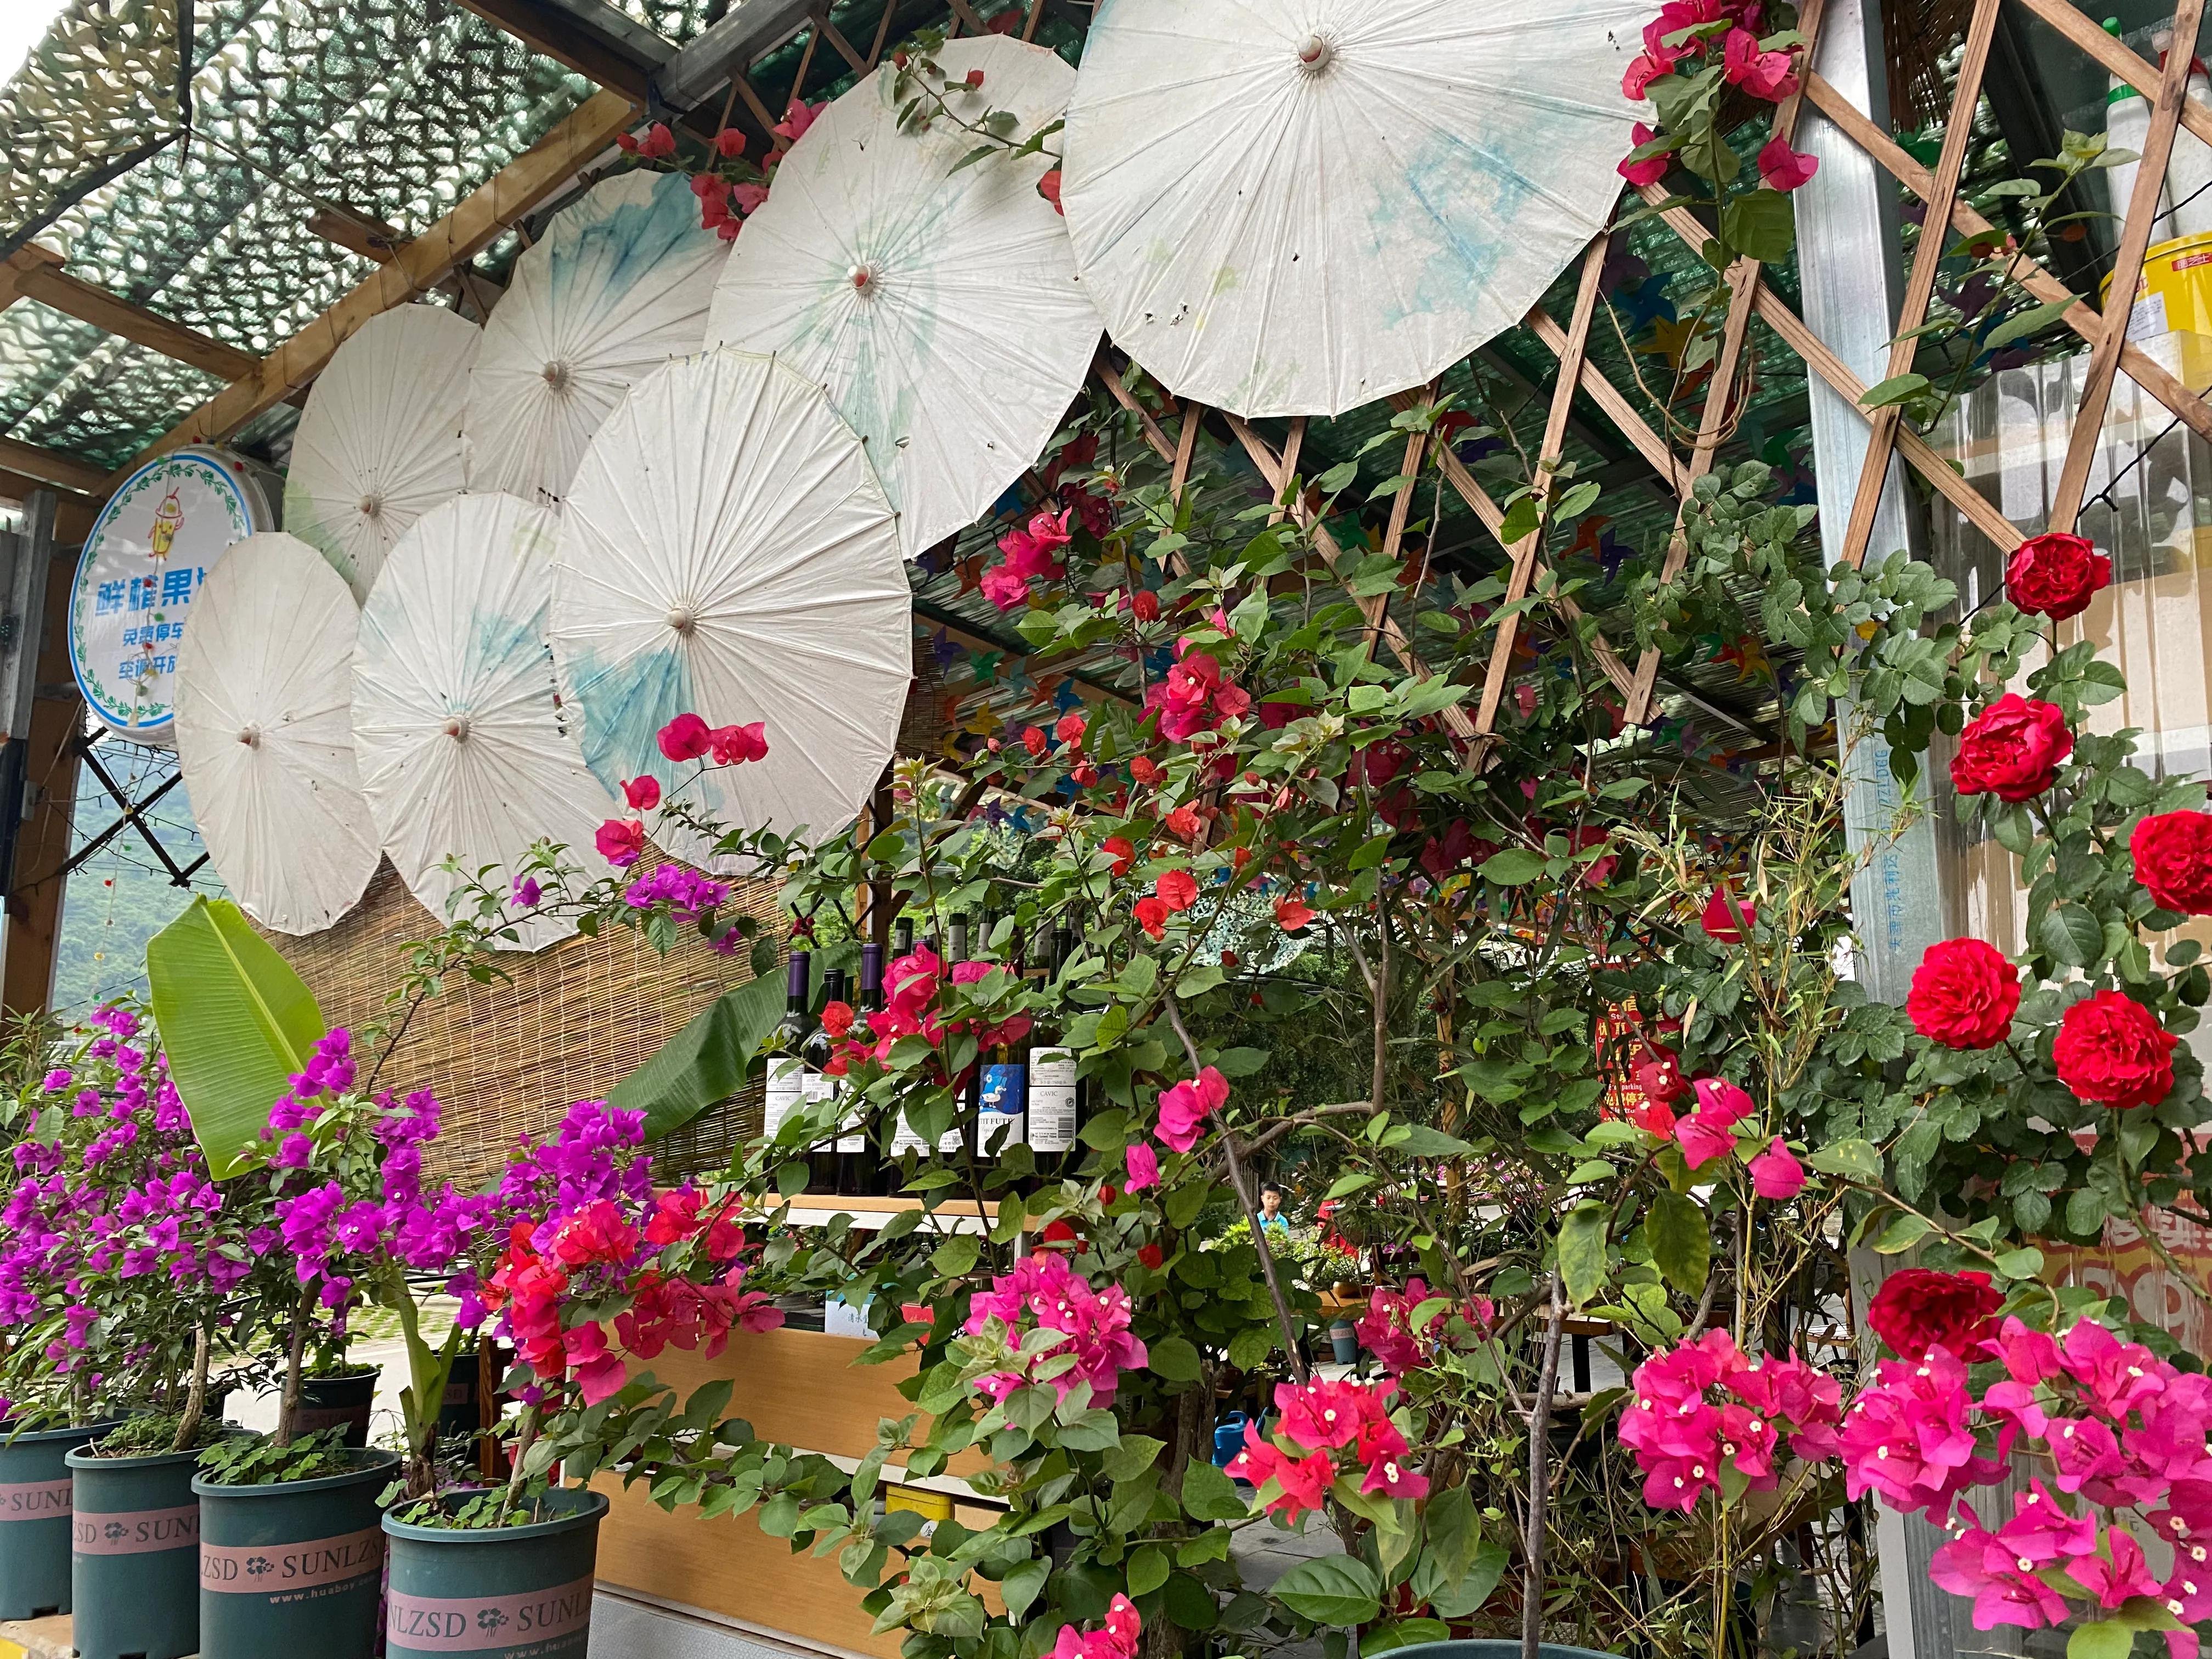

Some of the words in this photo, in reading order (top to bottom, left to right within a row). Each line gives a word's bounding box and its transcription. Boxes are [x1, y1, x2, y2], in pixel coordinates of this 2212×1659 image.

[123, 622, 184, 646] 免费停车
[201, 1554, 238, 1581] ZSD
